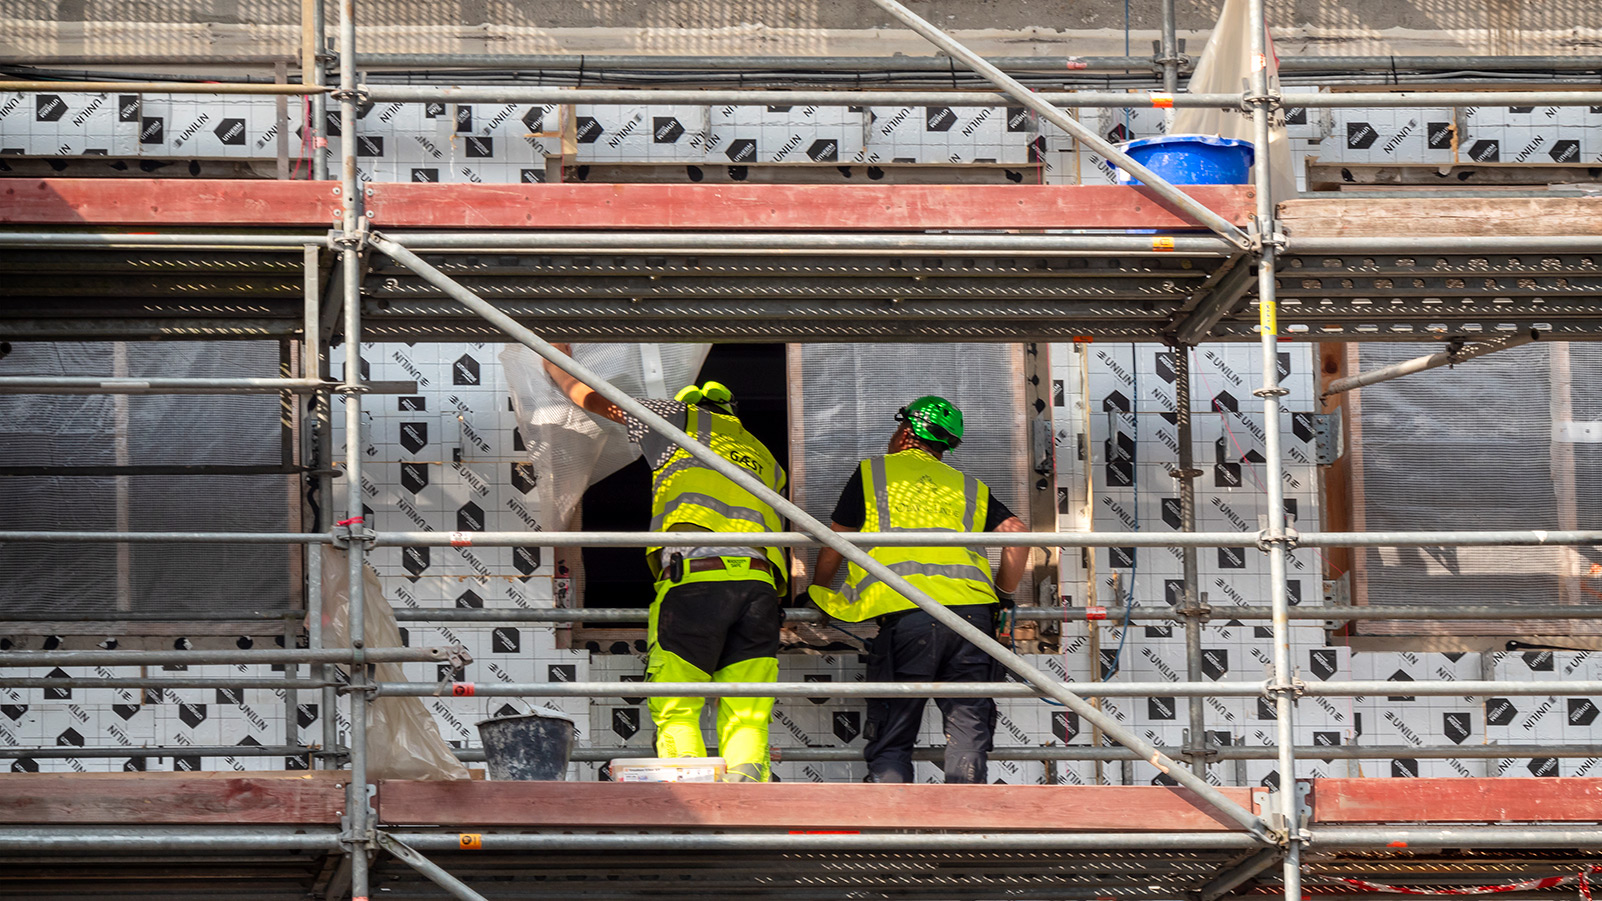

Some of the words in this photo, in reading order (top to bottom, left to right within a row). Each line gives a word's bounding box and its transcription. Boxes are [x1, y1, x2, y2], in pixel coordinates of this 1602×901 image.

[39, 98, 59, 118] UTHERM
[73, 99, 102, 127] UNILIN
[881, 108, 910, 136] UNILIN
[929, 108, 949, 128] UTHERM
[180, 113, 210, 141] UNILIN
[223, 122, 243, 142] UTHERM
[609, 121, 637, 149] UNILIN
[657, 121, 677, 140] UTHERM
[962, 108, 991, 137] UNILIN
[1350, 126, 1370, 145] UTHERM
[773, 134, 802, 162] UNILIN
[1383, 126, 1411, 154] UNILIN
[1515, 135, 1544, 162] UNILIN
[392, 352, 422, 381] UNILIN
[1105, 357, 1134, 386] UNILIN
[1213, 357, 1242, 386] UNILIN
[730, 450, 763, 475] GÆST
[460, 468, 490, 497] UNILIN
[396, 498, 426, 528] UNILIN
[507, 498, 537, 528] UNILIN
[1220, 504, 1250, 532] UNILIN
[1150, 654, 1180, 682] UNILIN
[238, 704, 269, 731] UNILIN
[433, 702, 463, 731] UNILIN
[1489, 702, 1509, 722] UTHERM
[1523, 702, 1552, 731] UNILIN
[1571, 702, 1591, 722] UTHERM
[782, 717, 811, 745] UNILIN
[1001, 718, 1031, 745] UNILIN
[1393, 719, 1422, 746] UNILIN
